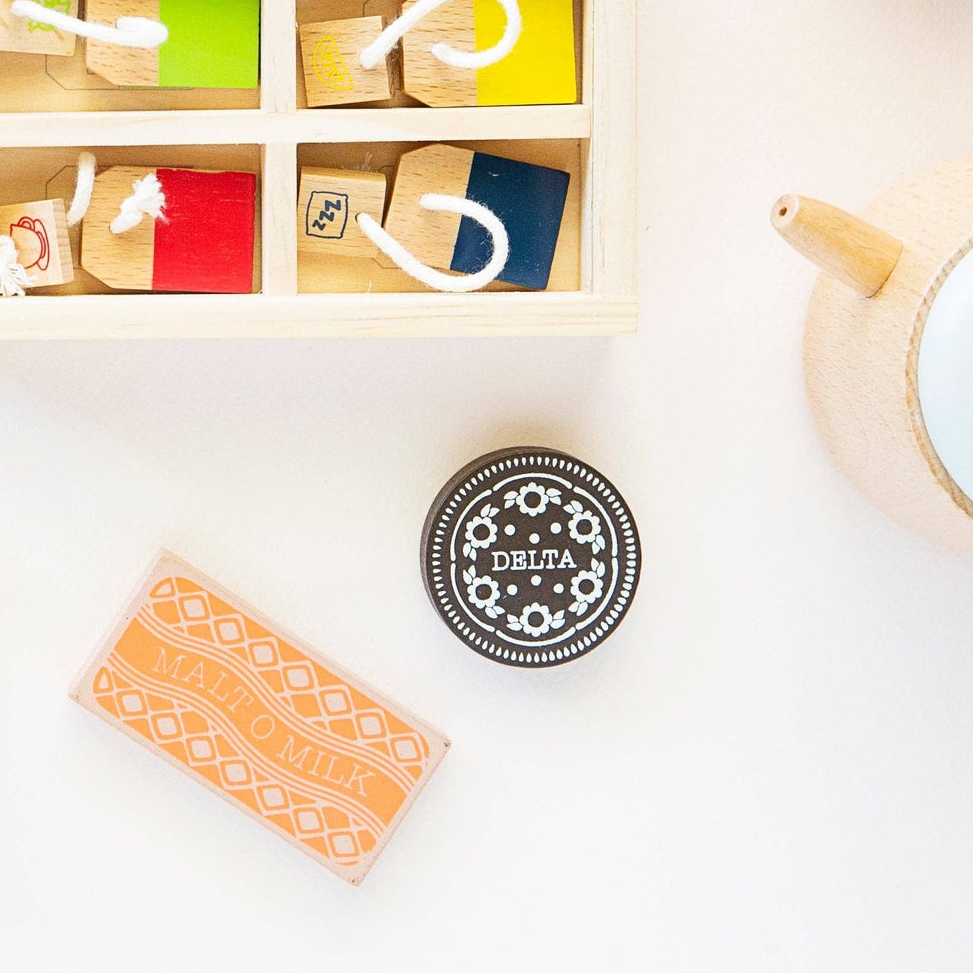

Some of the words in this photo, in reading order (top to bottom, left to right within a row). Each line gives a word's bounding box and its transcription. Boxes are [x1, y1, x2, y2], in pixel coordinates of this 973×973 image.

[491, 548, 578, 572] DELTA
[153, 647, 255, 713] MALT
[250, 714, 276, 740] O
[279, 735, 377, 798] MILK
